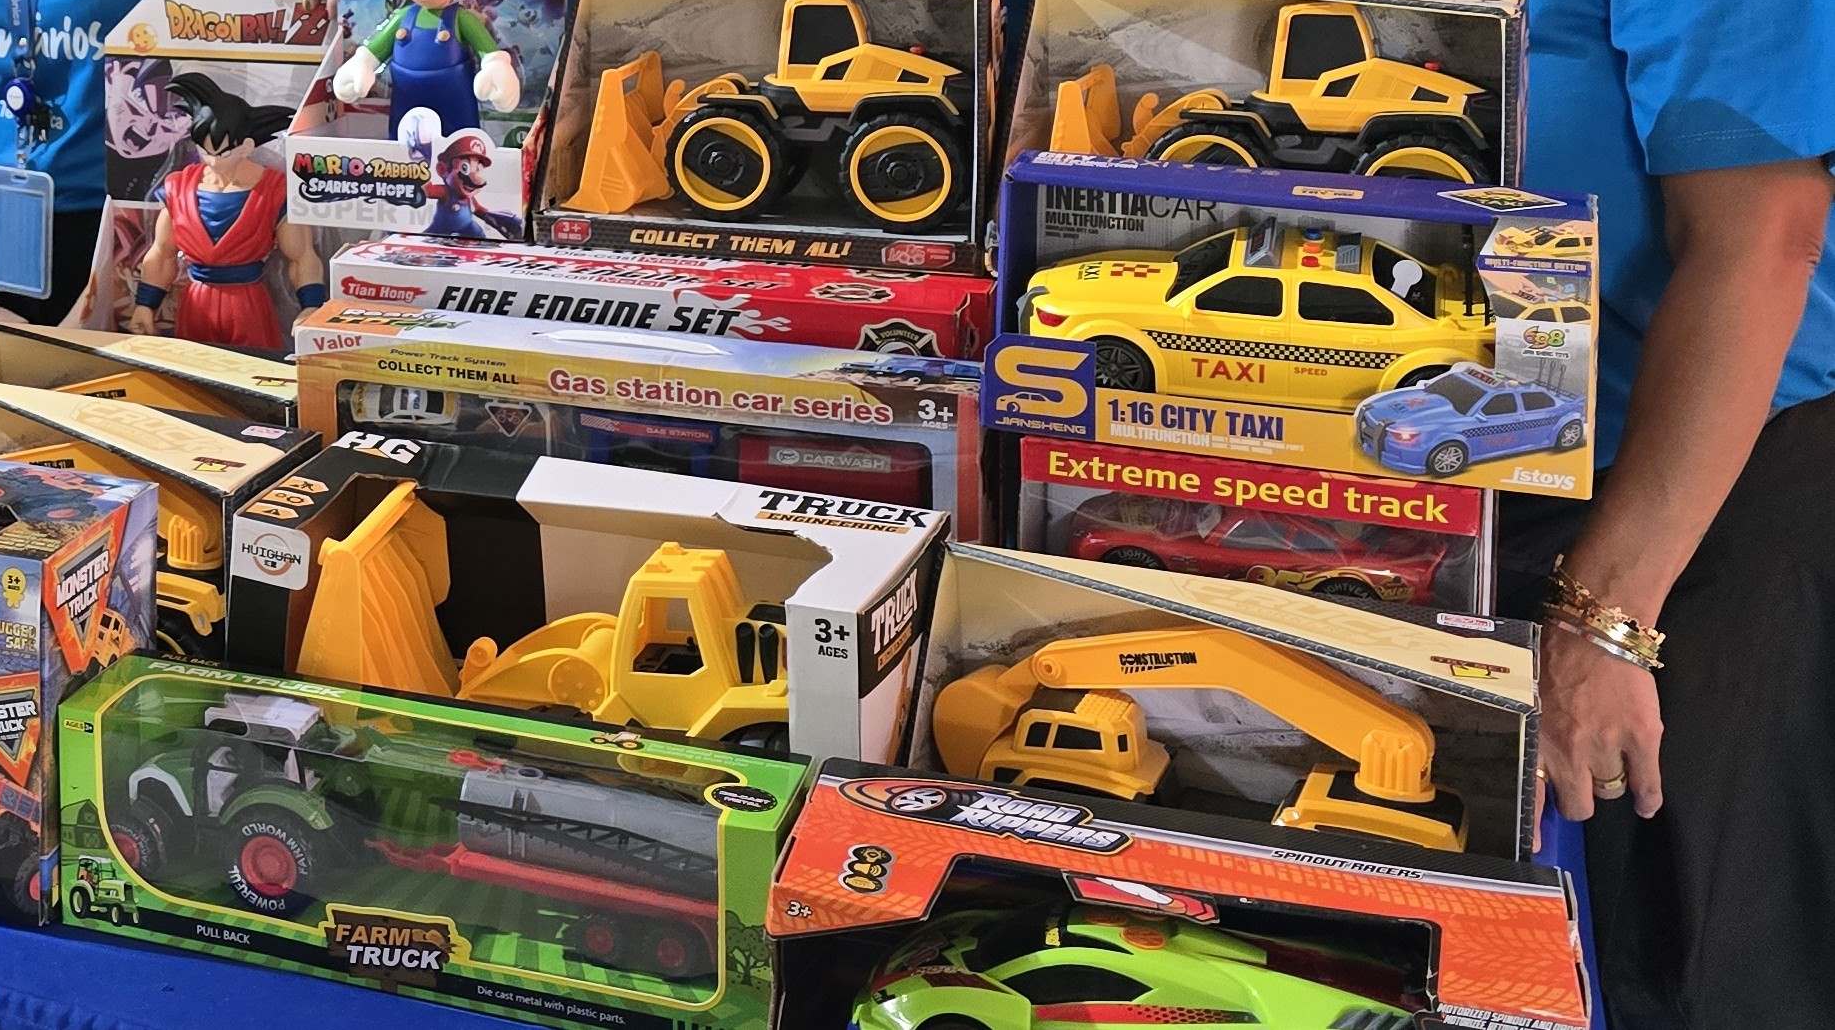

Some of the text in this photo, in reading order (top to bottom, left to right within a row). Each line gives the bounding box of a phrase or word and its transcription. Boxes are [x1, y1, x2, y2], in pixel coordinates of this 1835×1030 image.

[293, 152, 432, 182] MARIO RABBIDS
[308, 177, 416, 199] SPARKS OF HOPE
[1045, 210, 1144, 232] MULTIFUNCTION
[628, 228, 852, 258] COLLECT THEM ALL!
[347, 280, 742, 338] Tian Hong FIRE ENGINE SET
[313, 334, 363, 352] Valor
[389, 348, 507, 368] Power Track System
[1191, 357, 1328, 384] TAXI SPEED
[377, 359, 519, 385] COLLECT THEM ALL
[548, 368, 894, 424] Gas station car series
[917, 399, 955, 422] 3+
[1108, 398, 1284, 441] 1:16 CITY TAXI
[994, 418, 1088, 435] JIANSHENG
[1109, 423, 1210, 447] MULTIFUNCTION
[331, 430, 421, 464] HG
[802, 453, 887, 471] CAR WASH
[1048, 450, 1450, 525] Extreme speed track
[758, 489, 931, 529] TRUCK
[765, 512, 898, 534] ENGINEERING
[7, 575, 22, 586] 3+
[56, 549, 111, 608] MONSTER
[67, 584, 99, 620] TRUCK
[870, 568, 918, 655] TRUCK
[5, 635, 38, 651] SAFE
[814, 618, 850, 644] 3+
[817, 645, 849, 660] AGES
[1118, 651, 1197, 667] CONSTRUCTION
[147, 661, 347, 698] FARM TRUCK
[970, 791, 1081, 824] ROAD
[950, 805, 1123, 849] RIPPERS
[1271, 849, 1424, 880] SPINOUT RACERS
[786, 901, 814, 918] 3+
[196, 924, 251, 945] PULL BACK
[335, 923, 411, 946] FARM
[346, 945, 442, 970] TRUCK
[476, 985, 626, 1026] Die cast metal with plastic parts.
[1437, 1003, 1491, 1019] MOTORIZED
